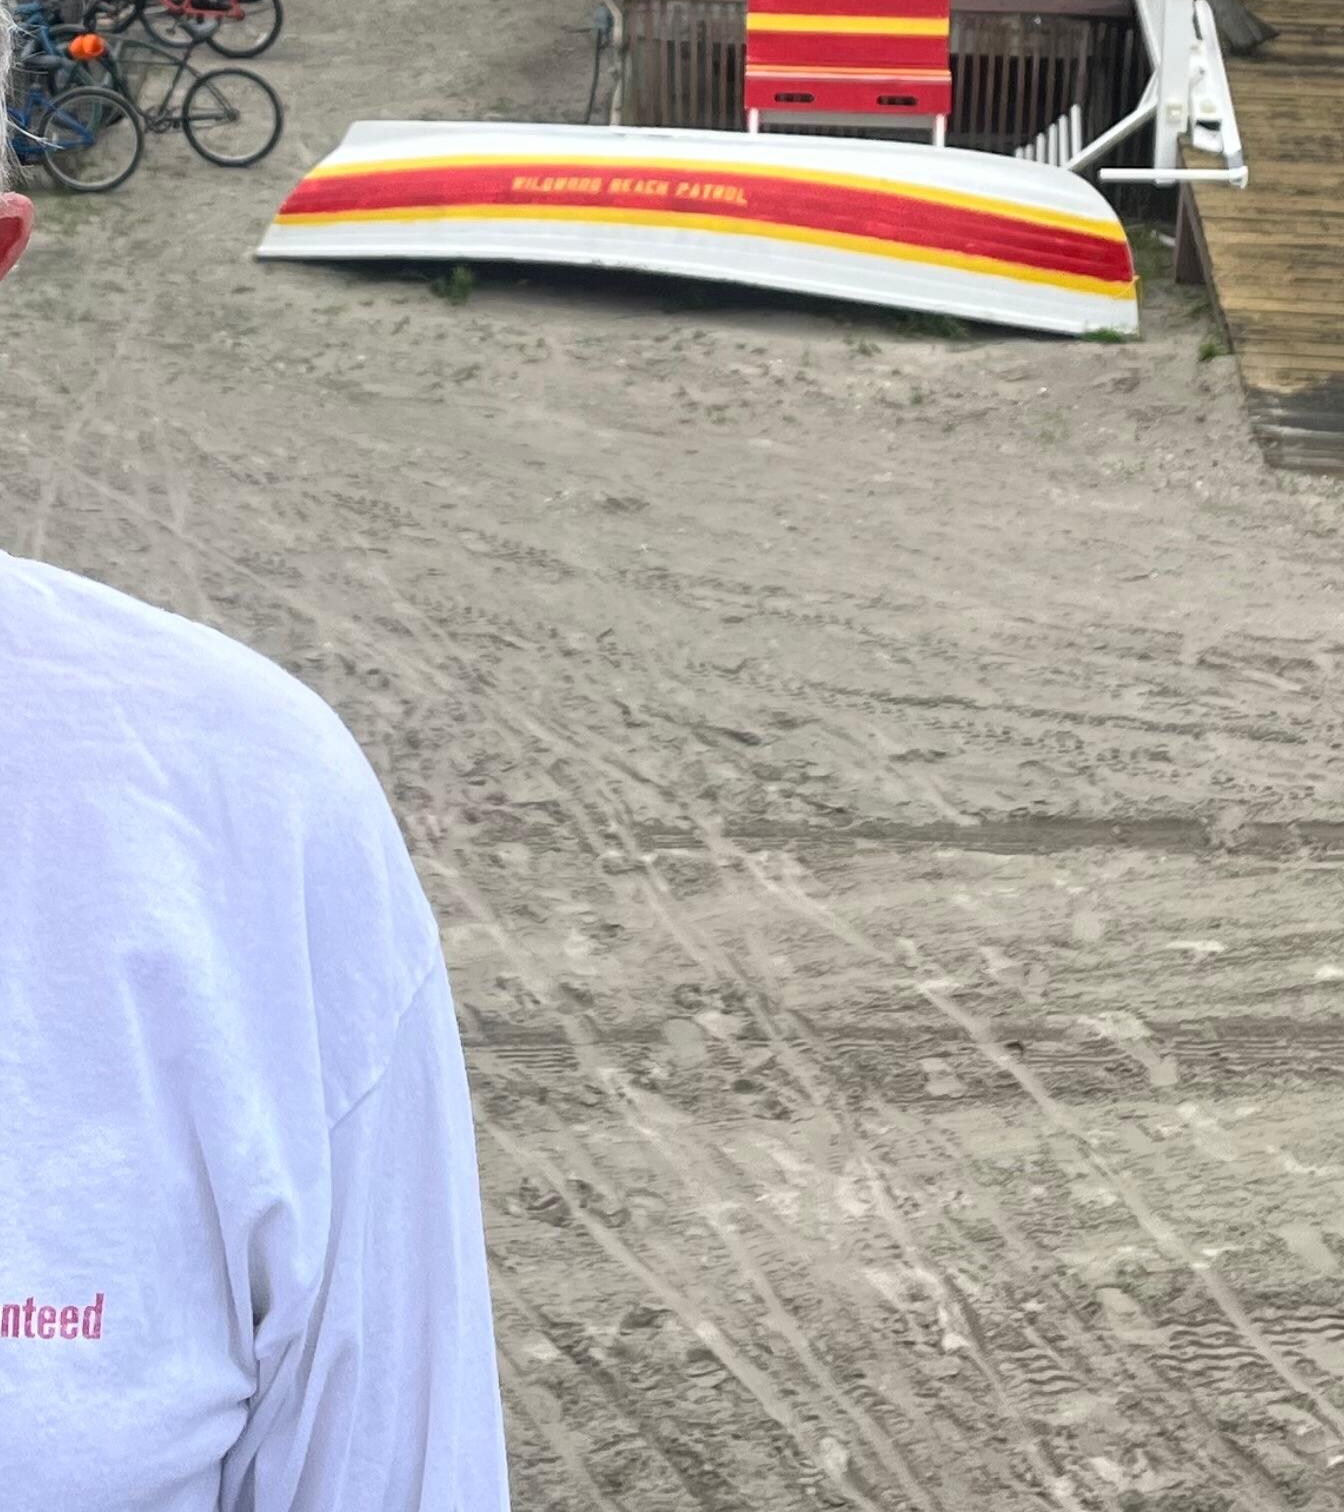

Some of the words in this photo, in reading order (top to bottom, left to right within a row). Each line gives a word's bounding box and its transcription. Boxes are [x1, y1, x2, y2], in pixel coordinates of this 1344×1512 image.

[511, 176, 603, 194] WILDWOOD
[608, 177, 670, 196] BEACH
[675, 181, 748, 206] PATROL
